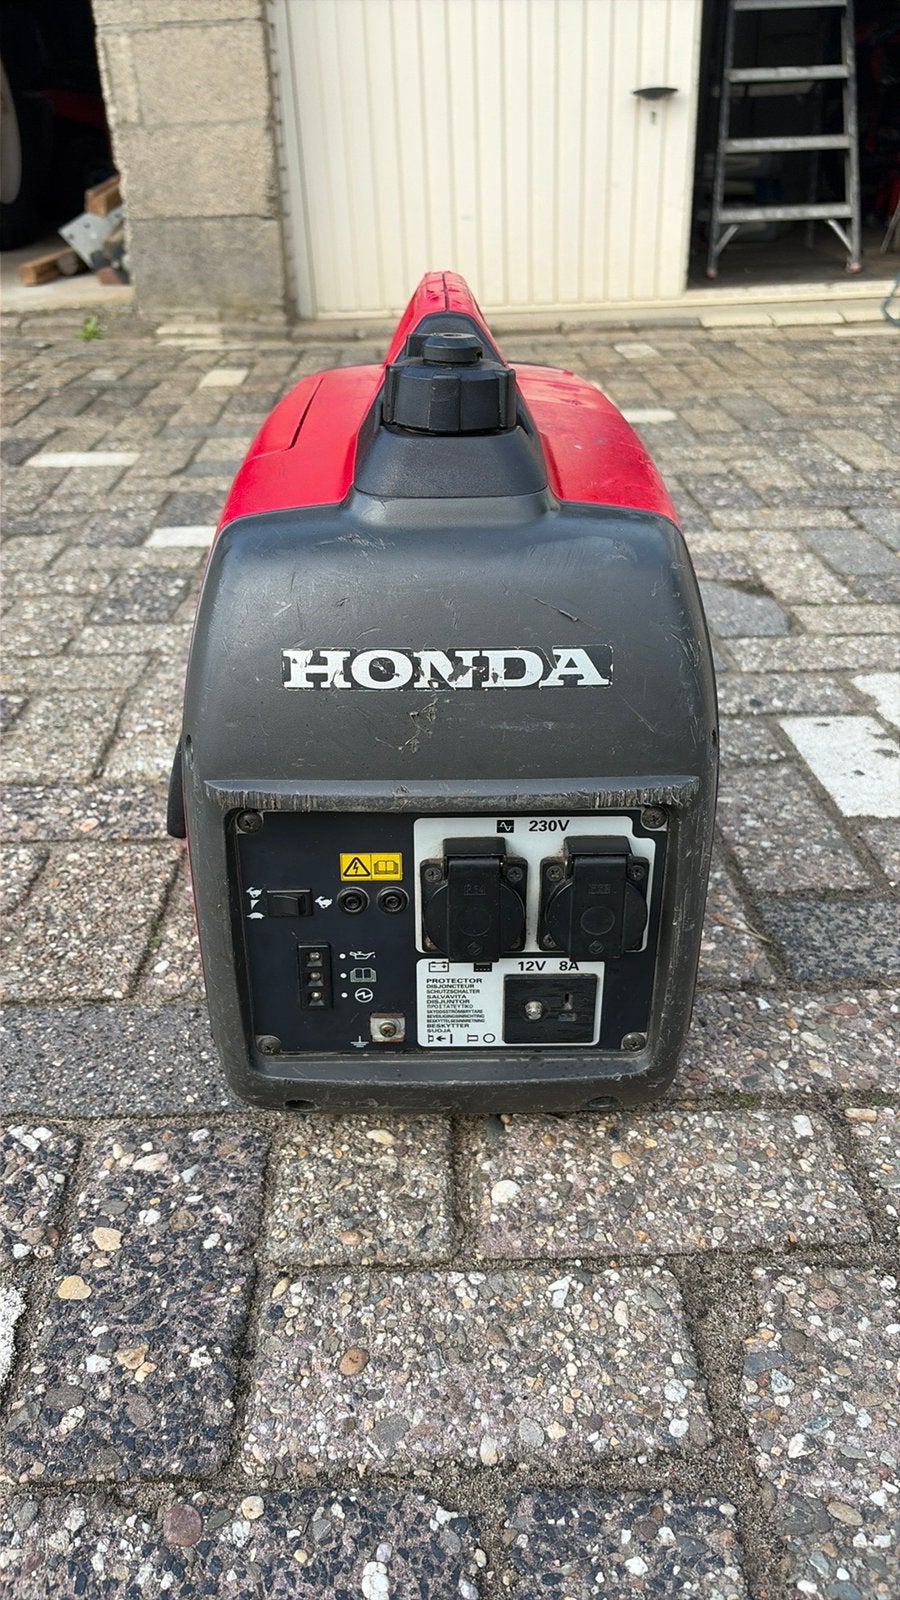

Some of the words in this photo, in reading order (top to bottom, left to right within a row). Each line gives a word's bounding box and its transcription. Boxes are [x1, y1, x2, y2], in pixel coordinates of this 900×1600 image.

[282, 649, 610, 689] HONDA
[529, 820, 570, 832] 230V
[518, 961, 546, 971] 12V
[559, 961, 579, 971] 8A
